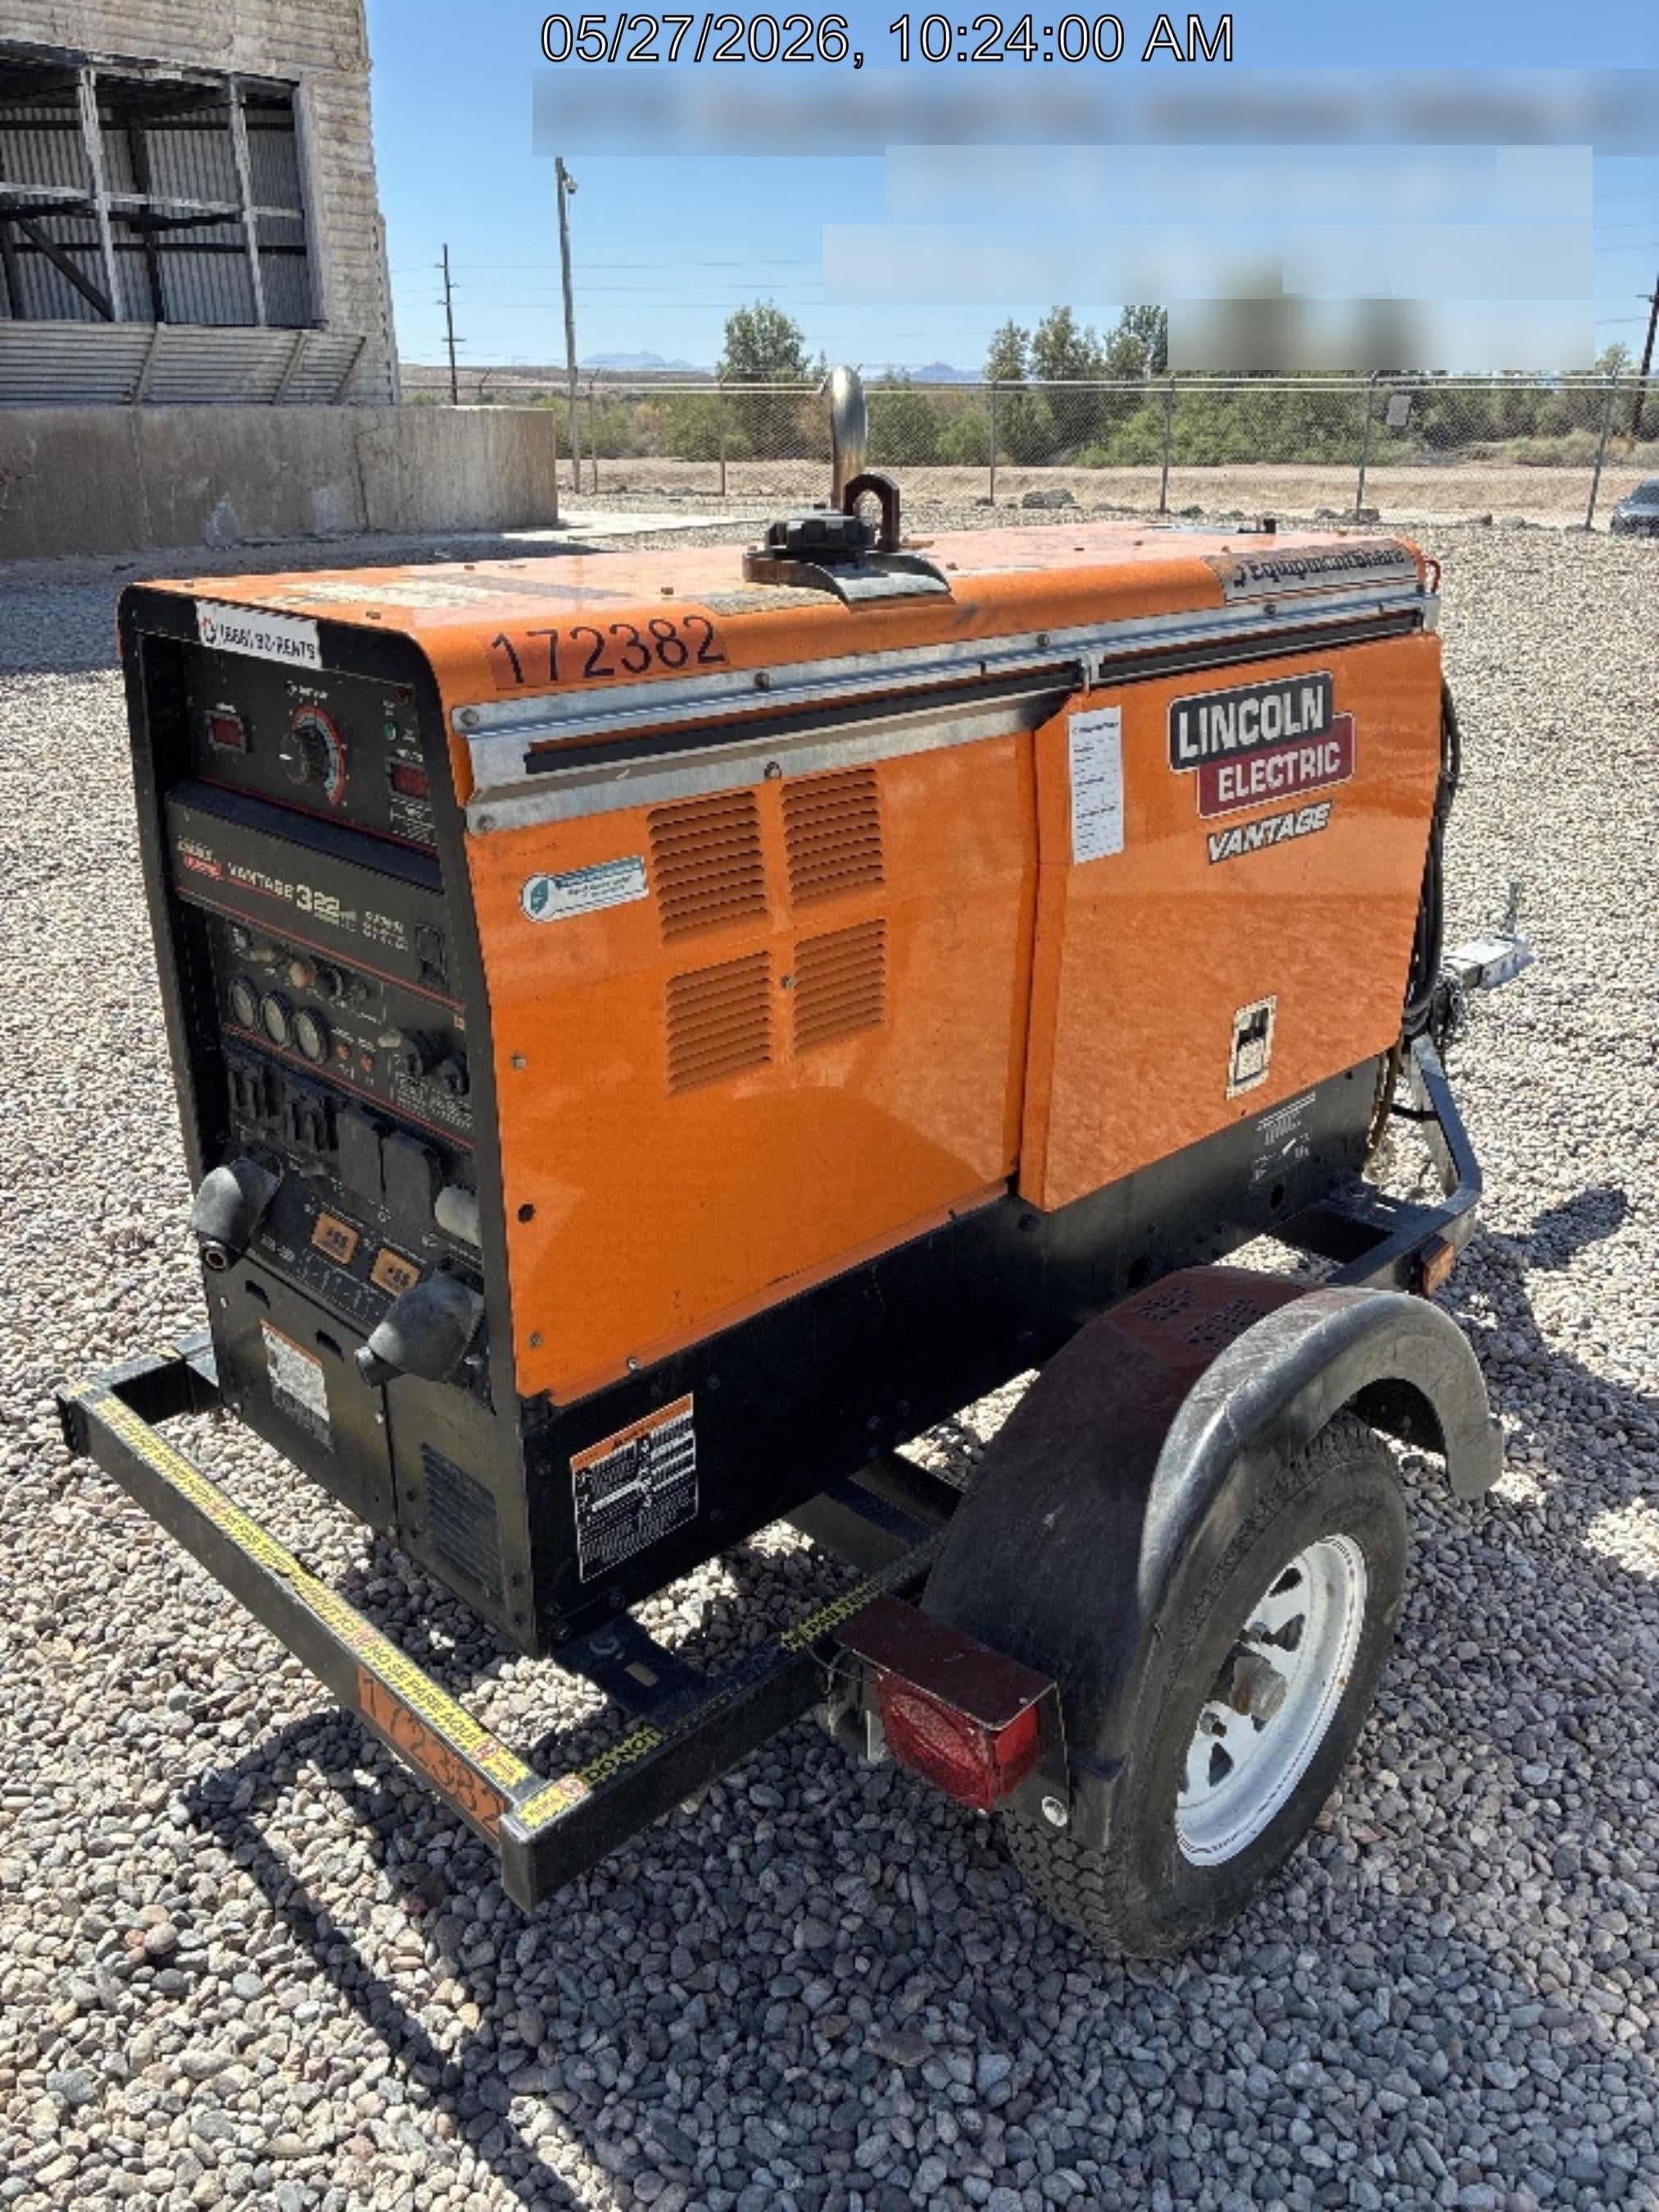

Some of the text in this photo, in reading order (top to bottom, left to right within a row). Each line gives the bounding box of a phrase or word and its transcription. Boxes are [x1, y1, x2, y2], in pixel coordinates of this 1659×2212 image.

[491, 614, 726, 684] 172382
[1179, 686, 1323, 760] LINCOLN
[1218, 741, 1340, 803] ELECTRIC
[1208, 801, 1333, 863] VANTAGE
[295, 883, 341, 913] 322
[369, 1645, 392, 1666] NO
[388, 1663, 410, 1681] SE
[406, 1678, 445, 1714] PARE
[584, 1731, 659, 1780] DO NOT
